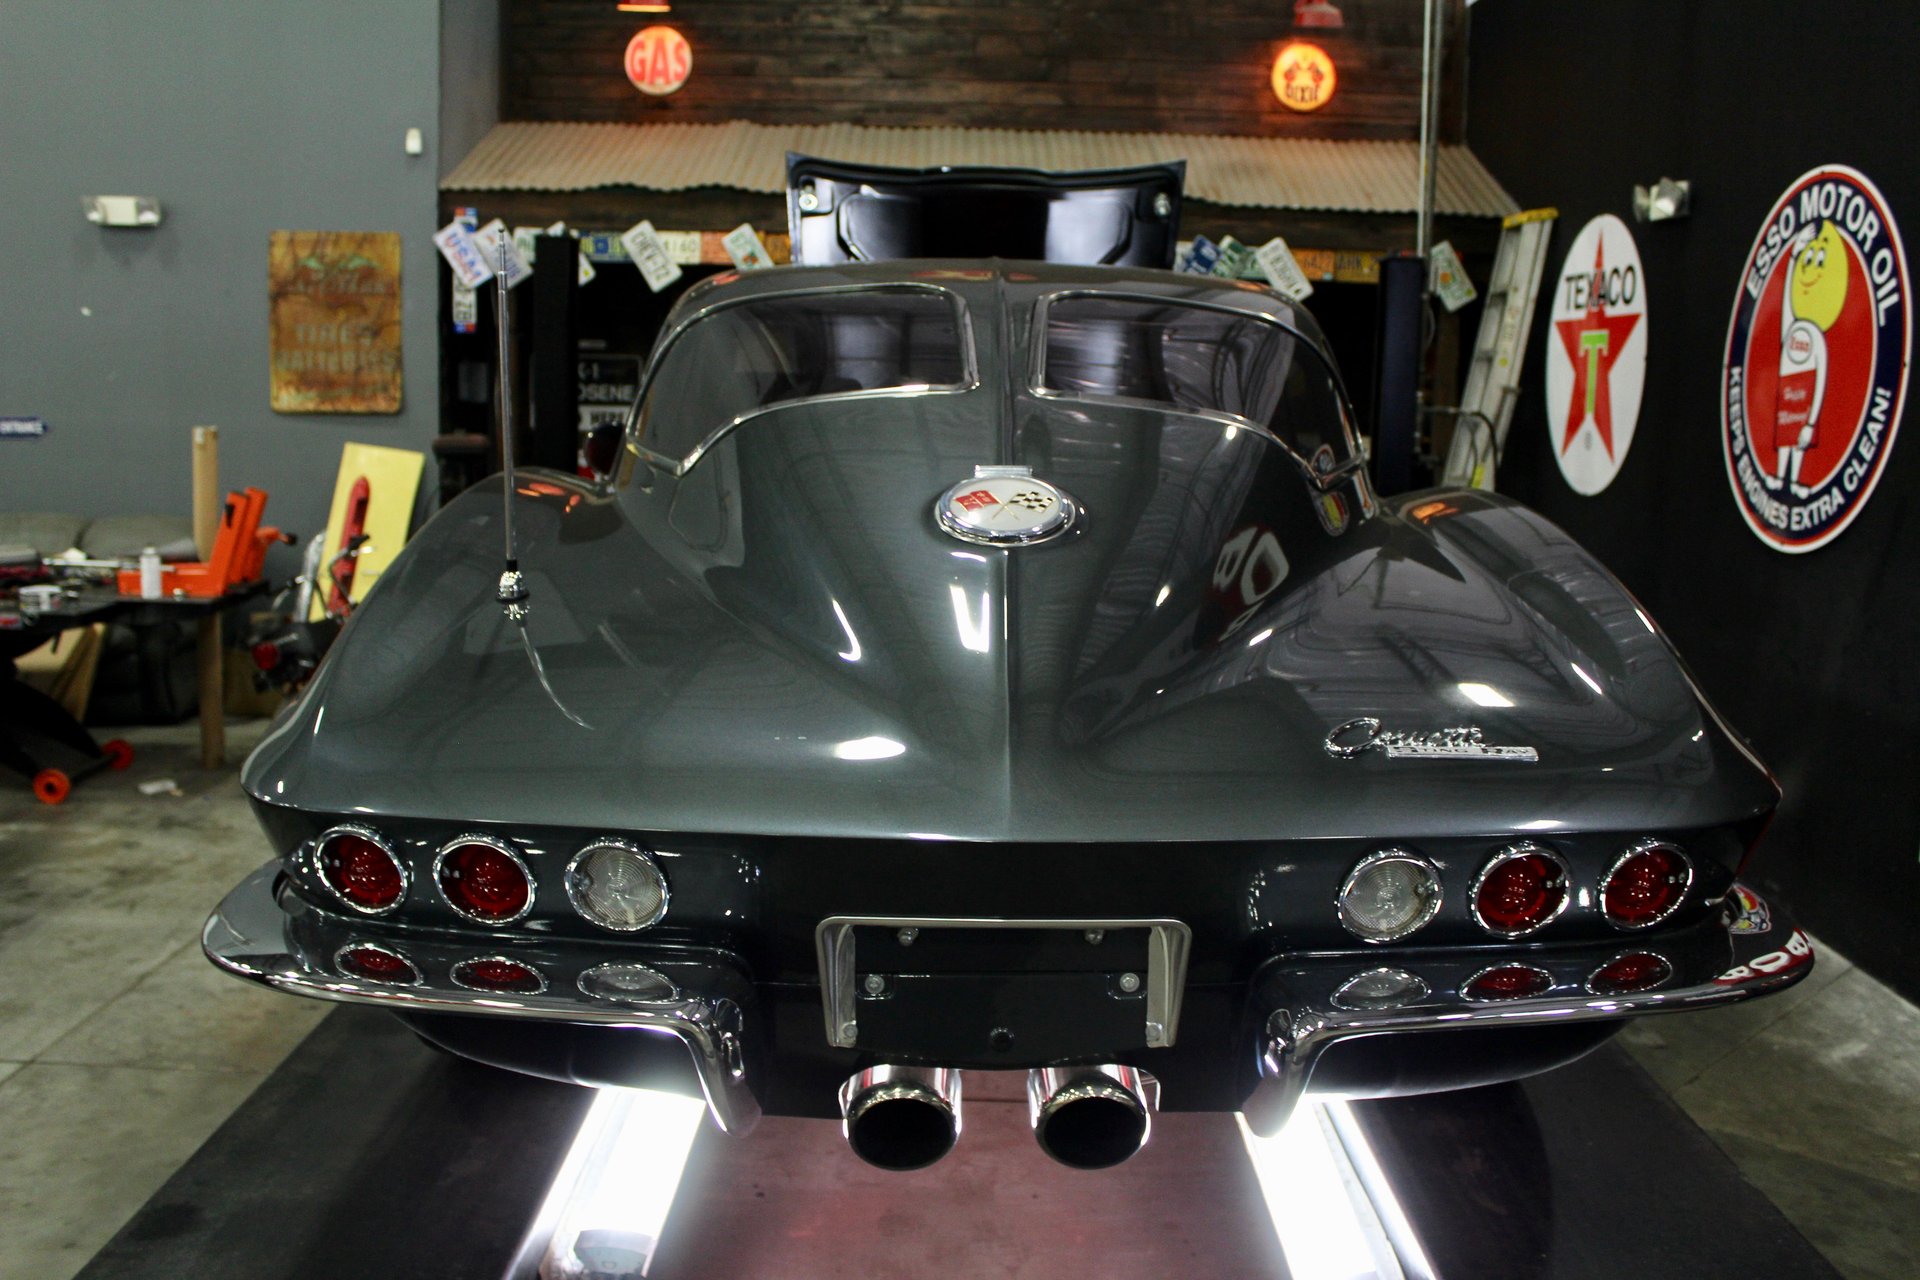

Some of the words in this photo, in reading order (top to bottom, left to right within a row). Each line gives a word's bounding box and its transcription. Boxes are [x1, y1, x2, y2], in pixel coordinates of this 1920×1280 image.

[630, 39, 688, 86] GAS
[1565, 264, 1637, 312] TEXACO
[1746, 205, 1796, 300] ESSO
[1800, 182, 1880, 254] MOTOR
[1872, 248, 1900, 328] OIL
[1578, 329, 1610, 414] T
[1728, 366, 1746, 455] KEEPS
[1737, 453, 1789, 530] ENGINES
[1790, 486, 1846, 532] EXTRA
[1843, 387, 1893, 493] CLEAN!
